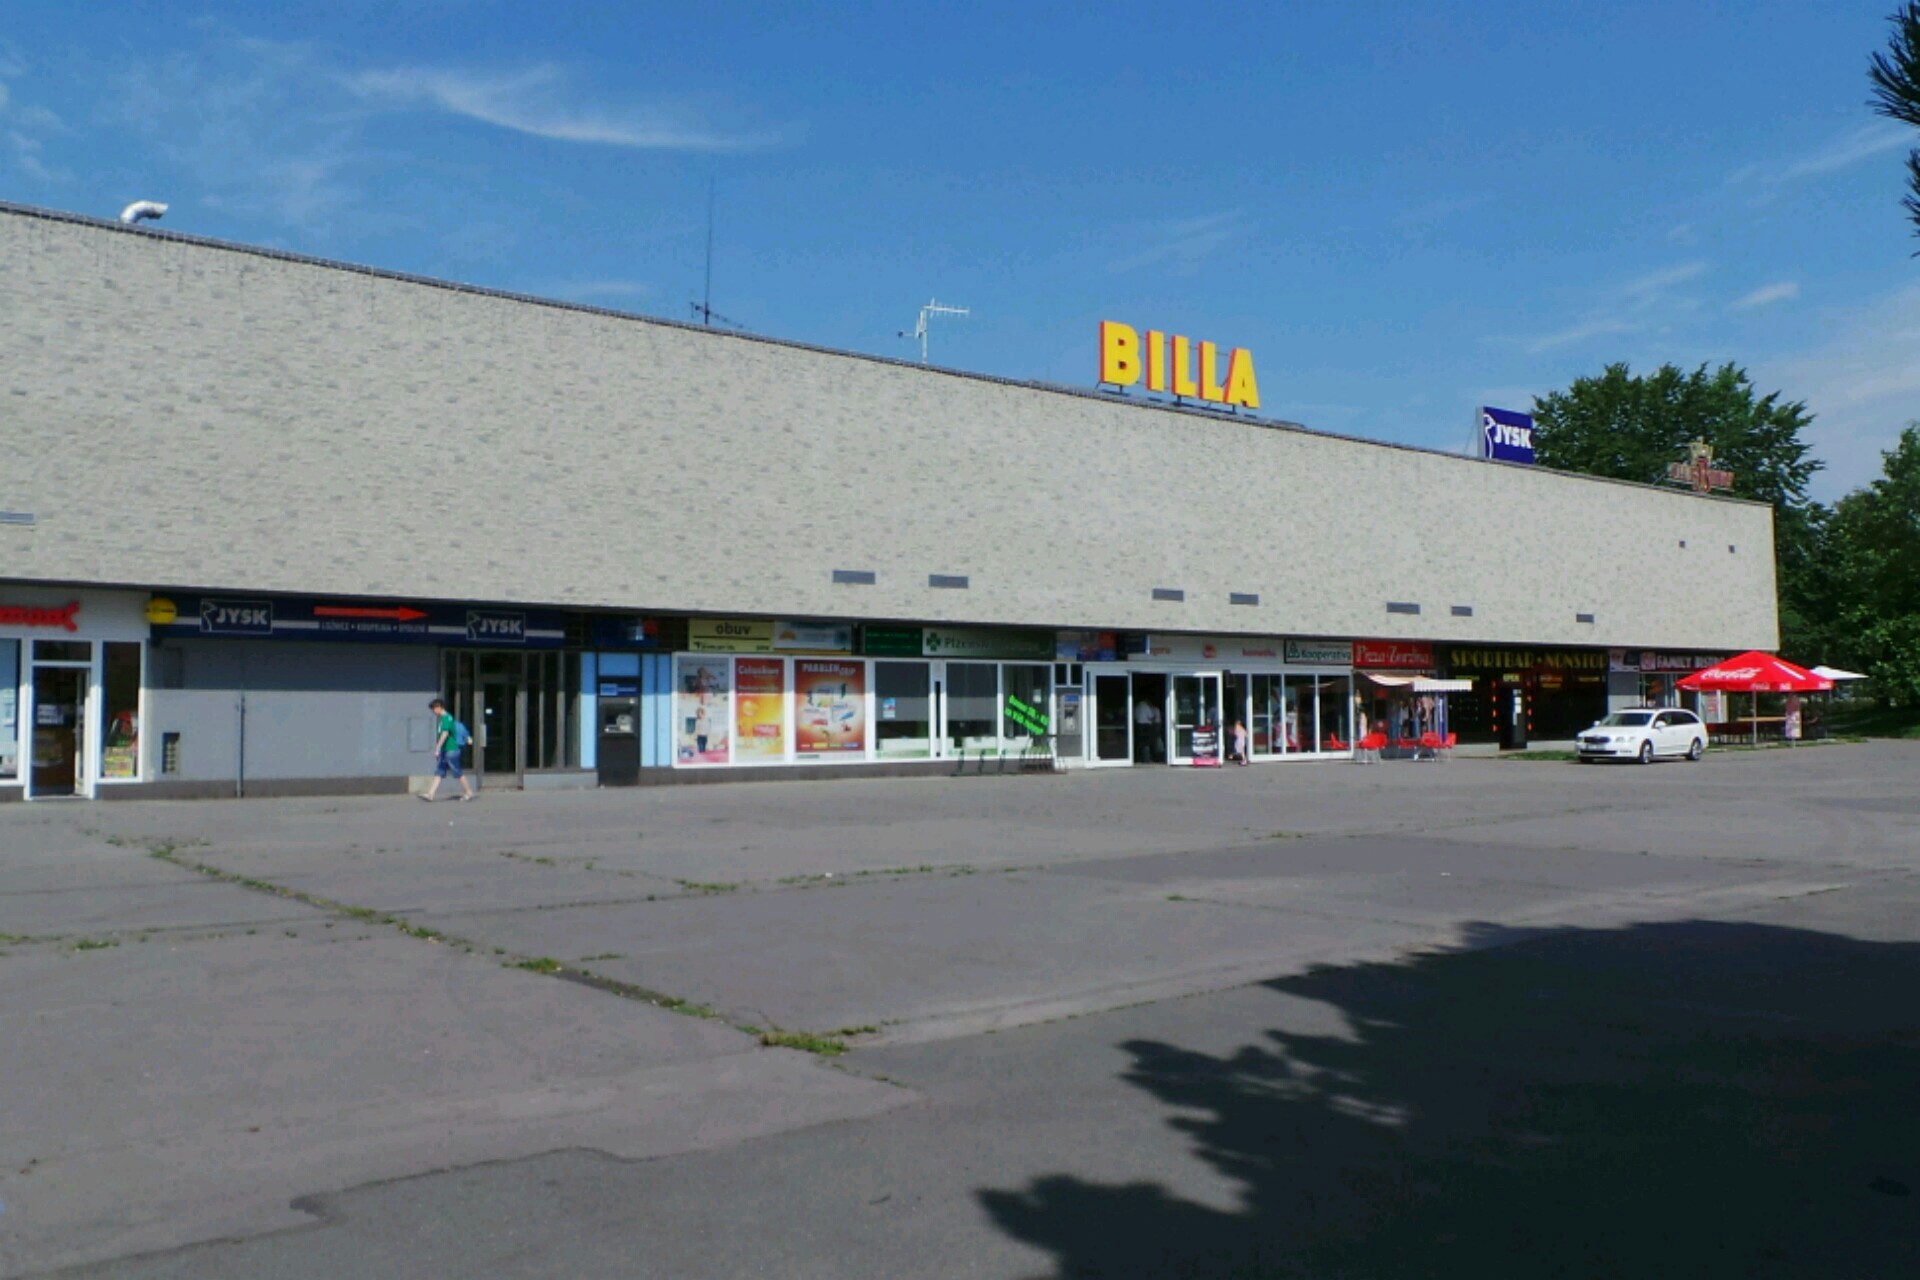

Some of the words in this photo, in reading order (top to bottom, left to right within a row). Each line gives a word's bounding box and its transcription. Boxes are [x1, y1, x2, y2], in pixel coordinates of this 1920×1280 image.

[1099, 320, 1261, 408] BILLA
[1494, 424, 1533, 449] JYSK
[215, 607, 268, 625] JYSK
[479, 618, 523, 635] JYSK
[715, 621, 752, 635] obuv
[1451, 650, 1534, 668] SPORTBAR
[1544, 653, 1609, 669] NONSTOP
